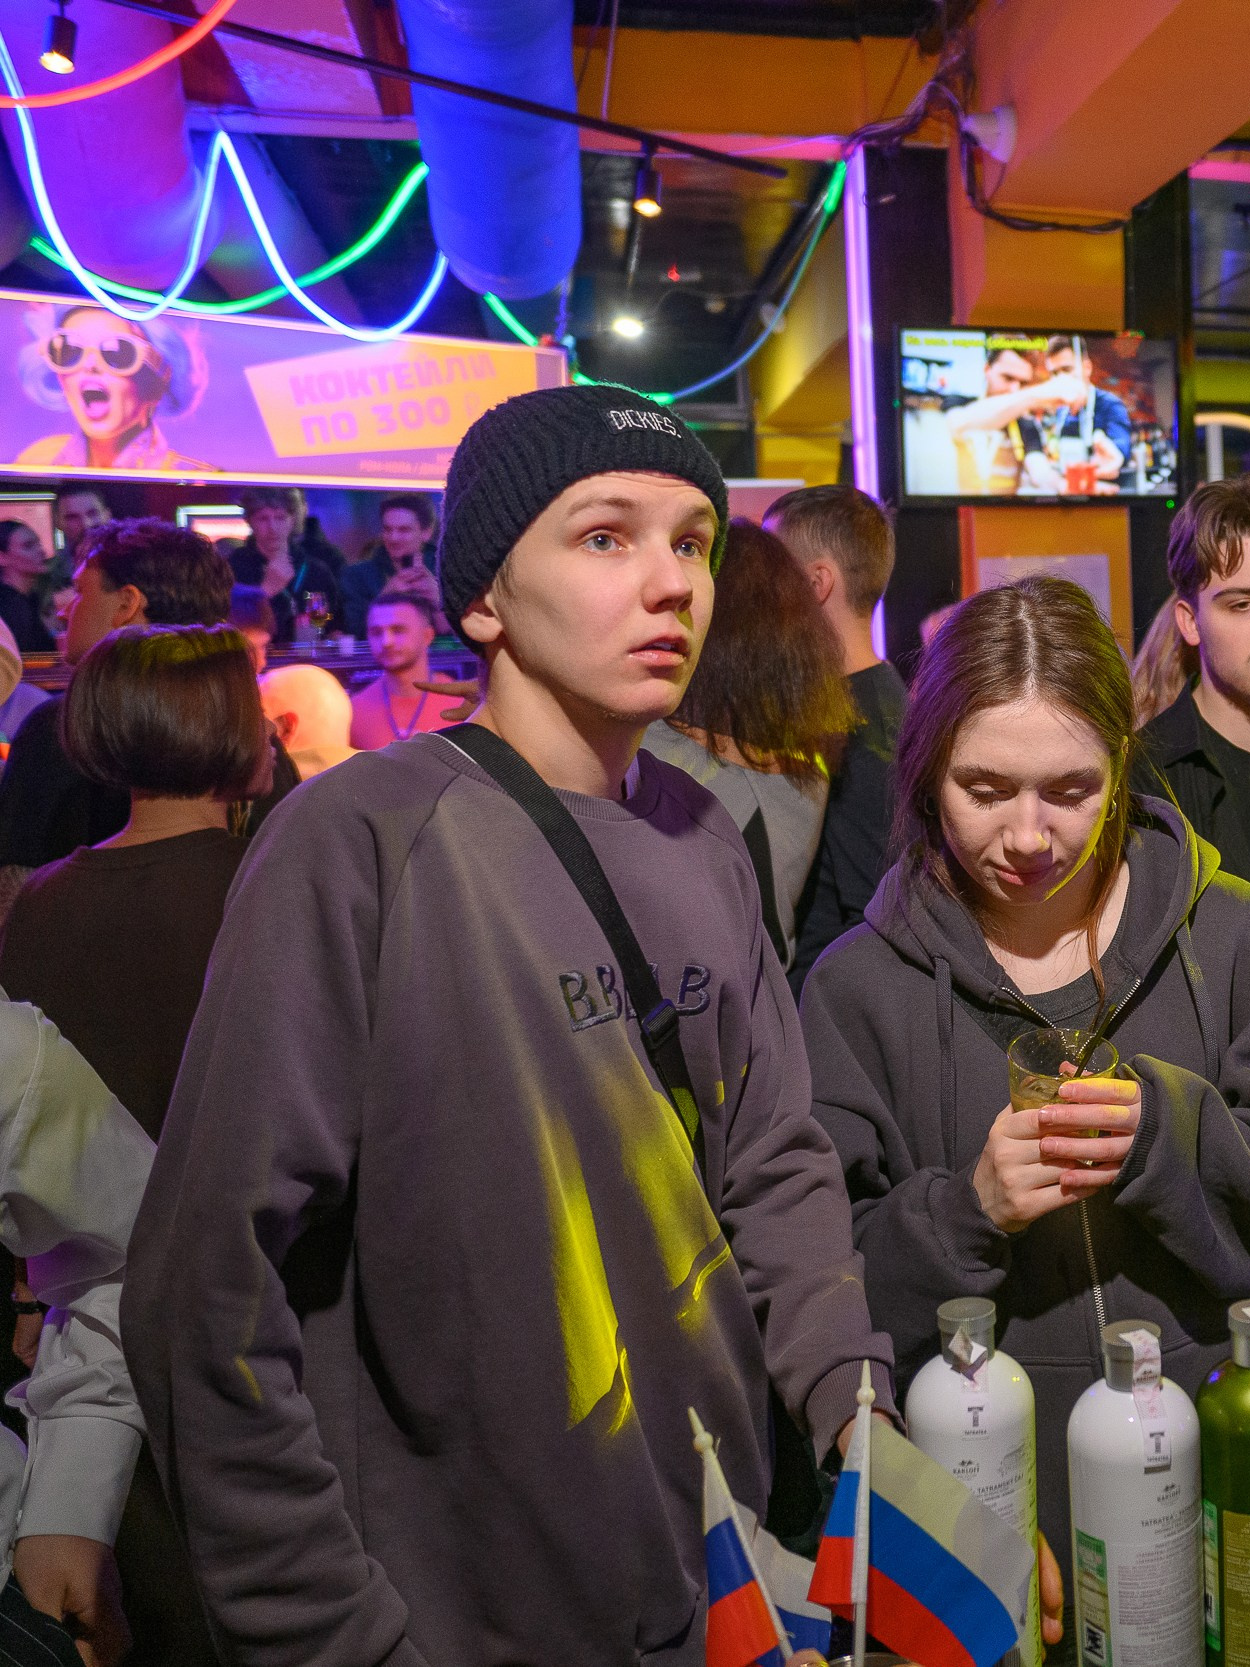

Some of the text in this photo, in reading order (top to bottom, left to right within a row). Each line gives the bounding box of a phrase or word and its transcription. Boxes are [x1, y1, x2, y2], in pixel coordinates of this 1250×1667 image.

[288, 352, 497, 408] КОКТЕЙЛИ
[300, 411, 359, 447] ПО
[371, 396, 450, 437] 300
